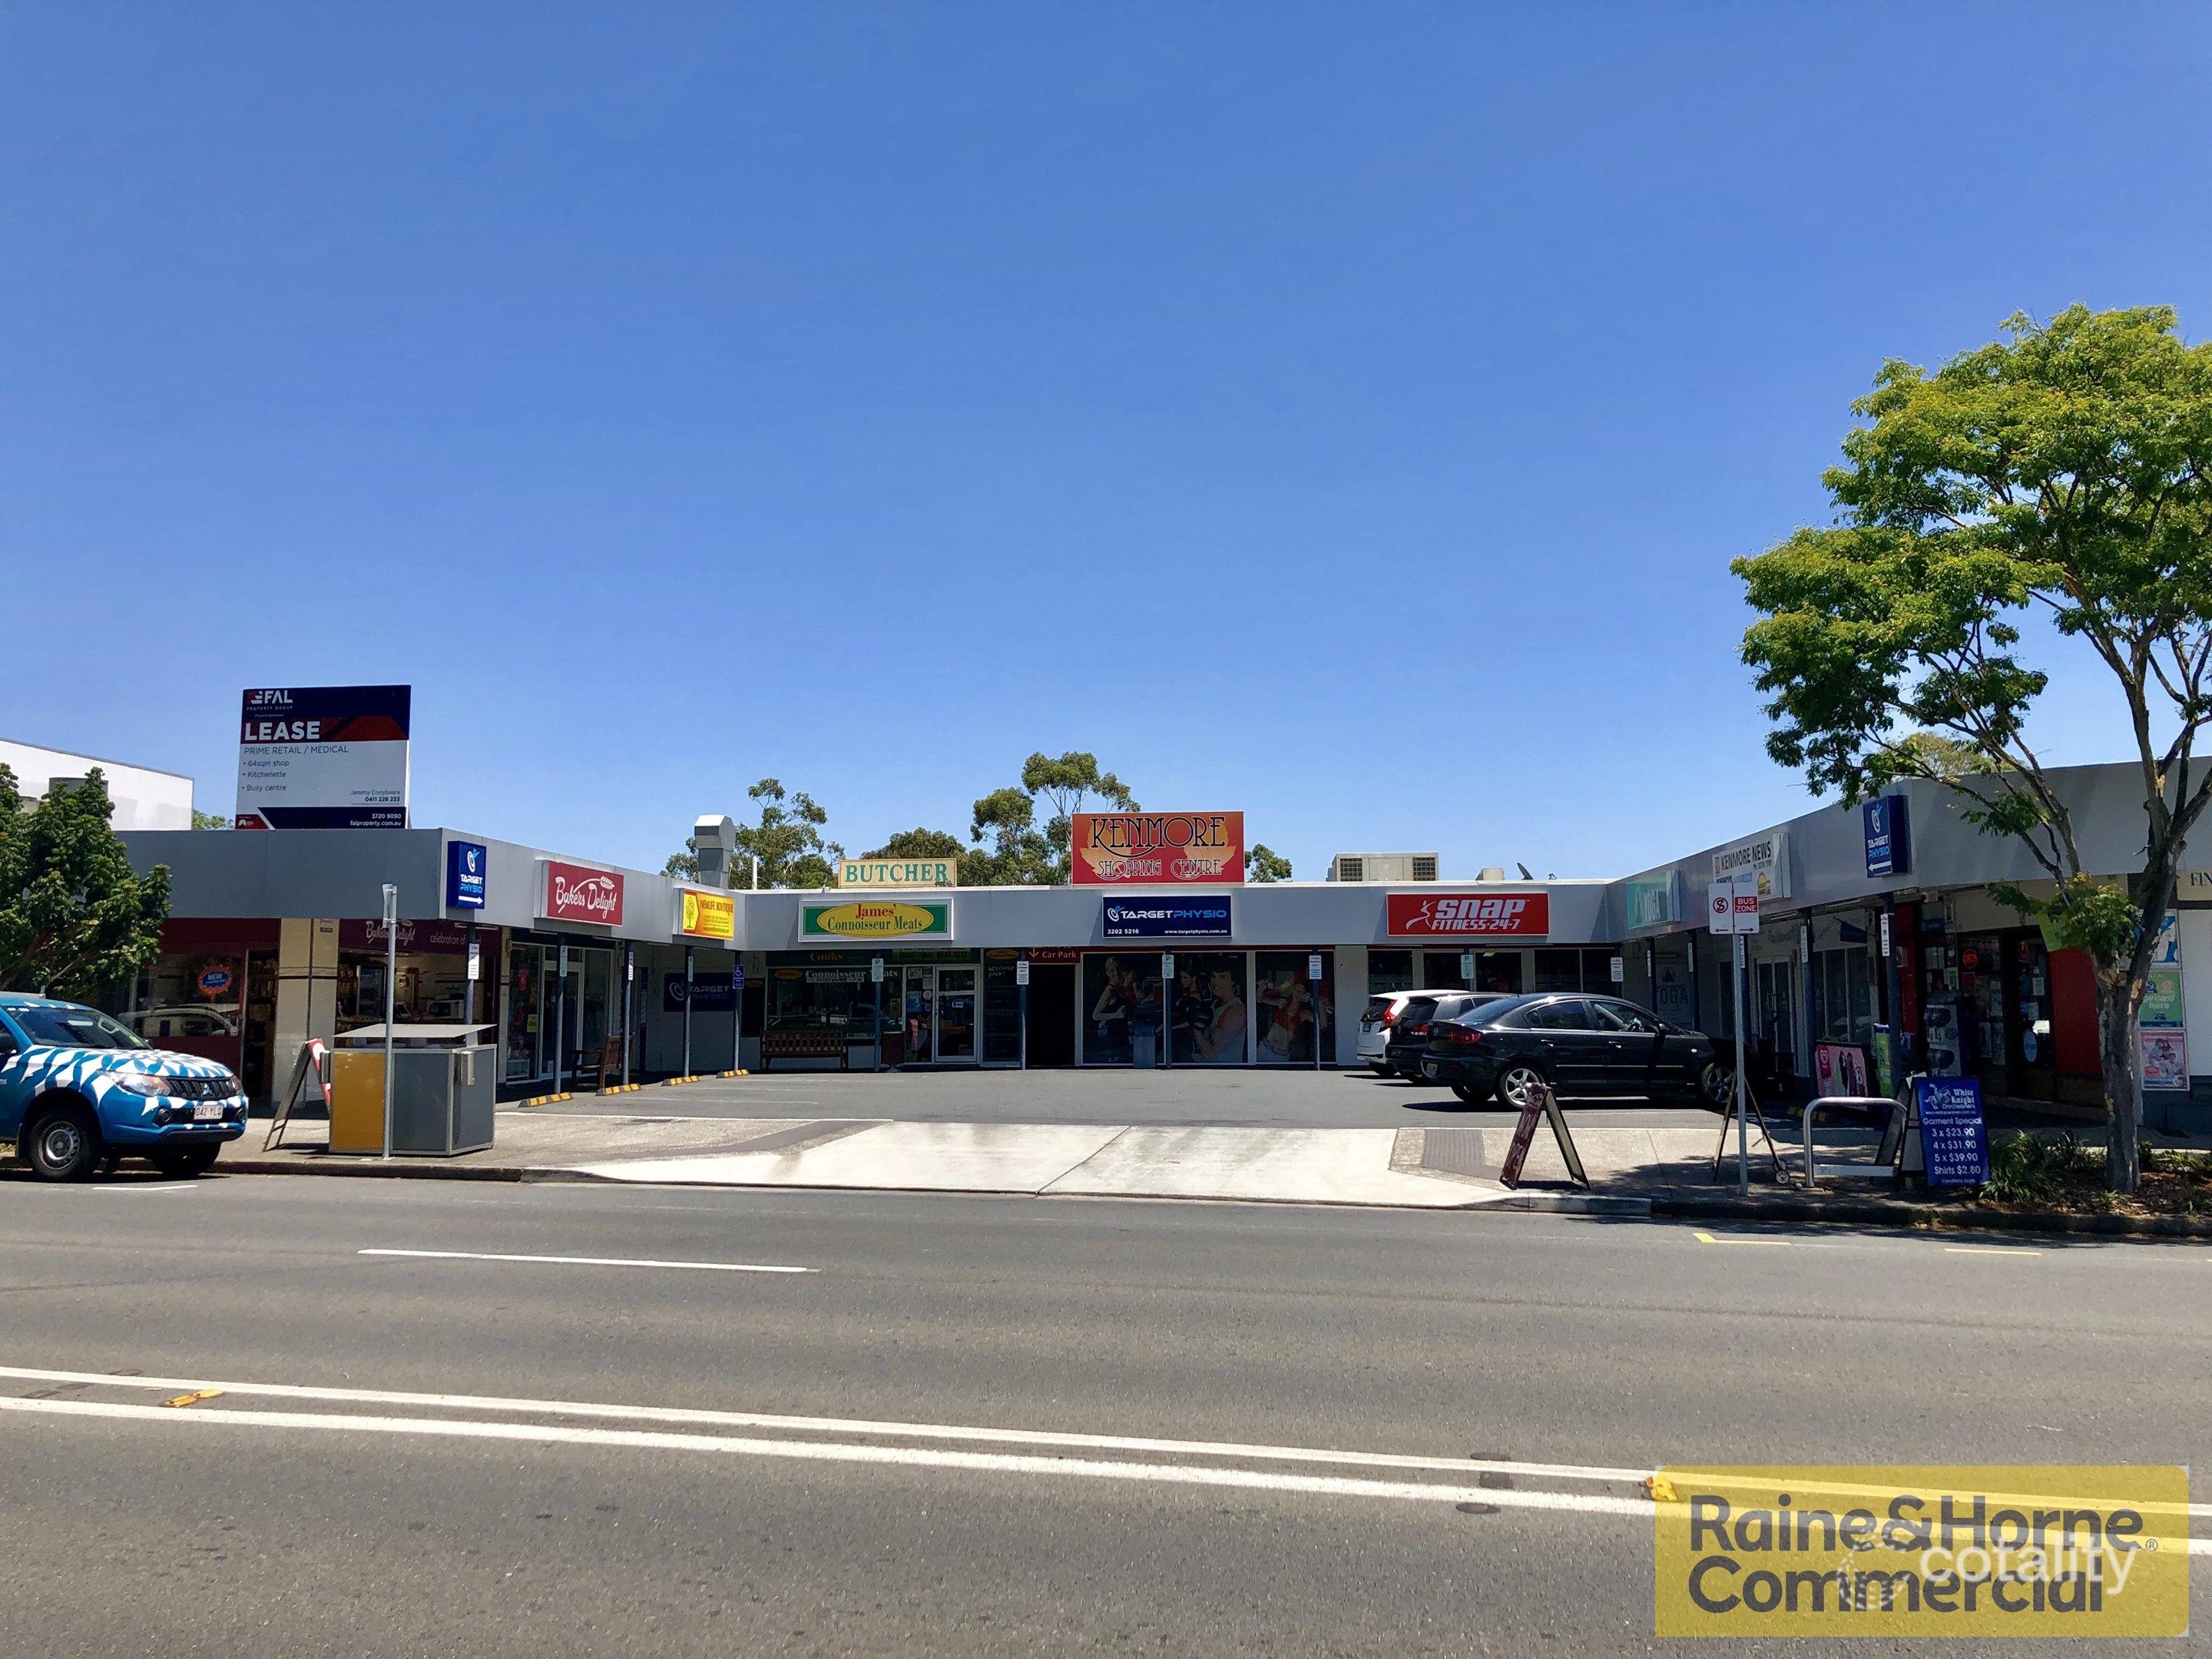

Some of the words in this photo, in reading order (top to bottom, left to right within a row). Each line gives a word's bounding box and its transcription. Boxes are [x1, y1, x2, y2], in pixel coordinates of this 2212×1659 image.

[244, 720, 320, 740] LEASE
[310, 745, 349, 753] MEDICAL
[1091, 816, 1225, 858] KENMORE
[1867, 834, 1889, 849] TARGET
[1720, 847, 1751, 871] KENMORE
[1751, 840, 1772, 862] NEWS
[1868, 846, 1890, 859] PHYSIO
[845, 863, 949, 882] BUTCHER
[1097, 859, 1161, 880] SHOPPING
[1171, 859, 1221, 880] CENTRE
[460, 873, 483, 885] TARGET
[460, 883, 483, 894] PHYSIO
[555, 876, 586, 909] Bakers
[587, 882, 618, 919] Delight
[855, 903, 897, 919] James'
[1644, 889, 1661, 923] YOGA
[828, 916, 891, 930] Connoisseur
[893, 916, 922, 930] Meats
[805, 969, 867, 979] Connoisseur
[1952, 1088, 1974, 1097] White
[1951, 1095, 1975, 1104] Knight
[1955, 1117, 1982, 1125] Special
[1932, 1128, 1937, 1137] 3
[1945, 1128, 1975, 1137] $23.90
[1933, 1141, 1939, 1149] 4
[1947, 1140, 1977, 1150] $31.90
[1934, 1153, 1940, 1162] 5
[1949, 1152, 1979, 1162] $39.90
[1934, 1165, 1955, 1175] Shirts
[1957, 1164, 1982, 1175] $2.80
